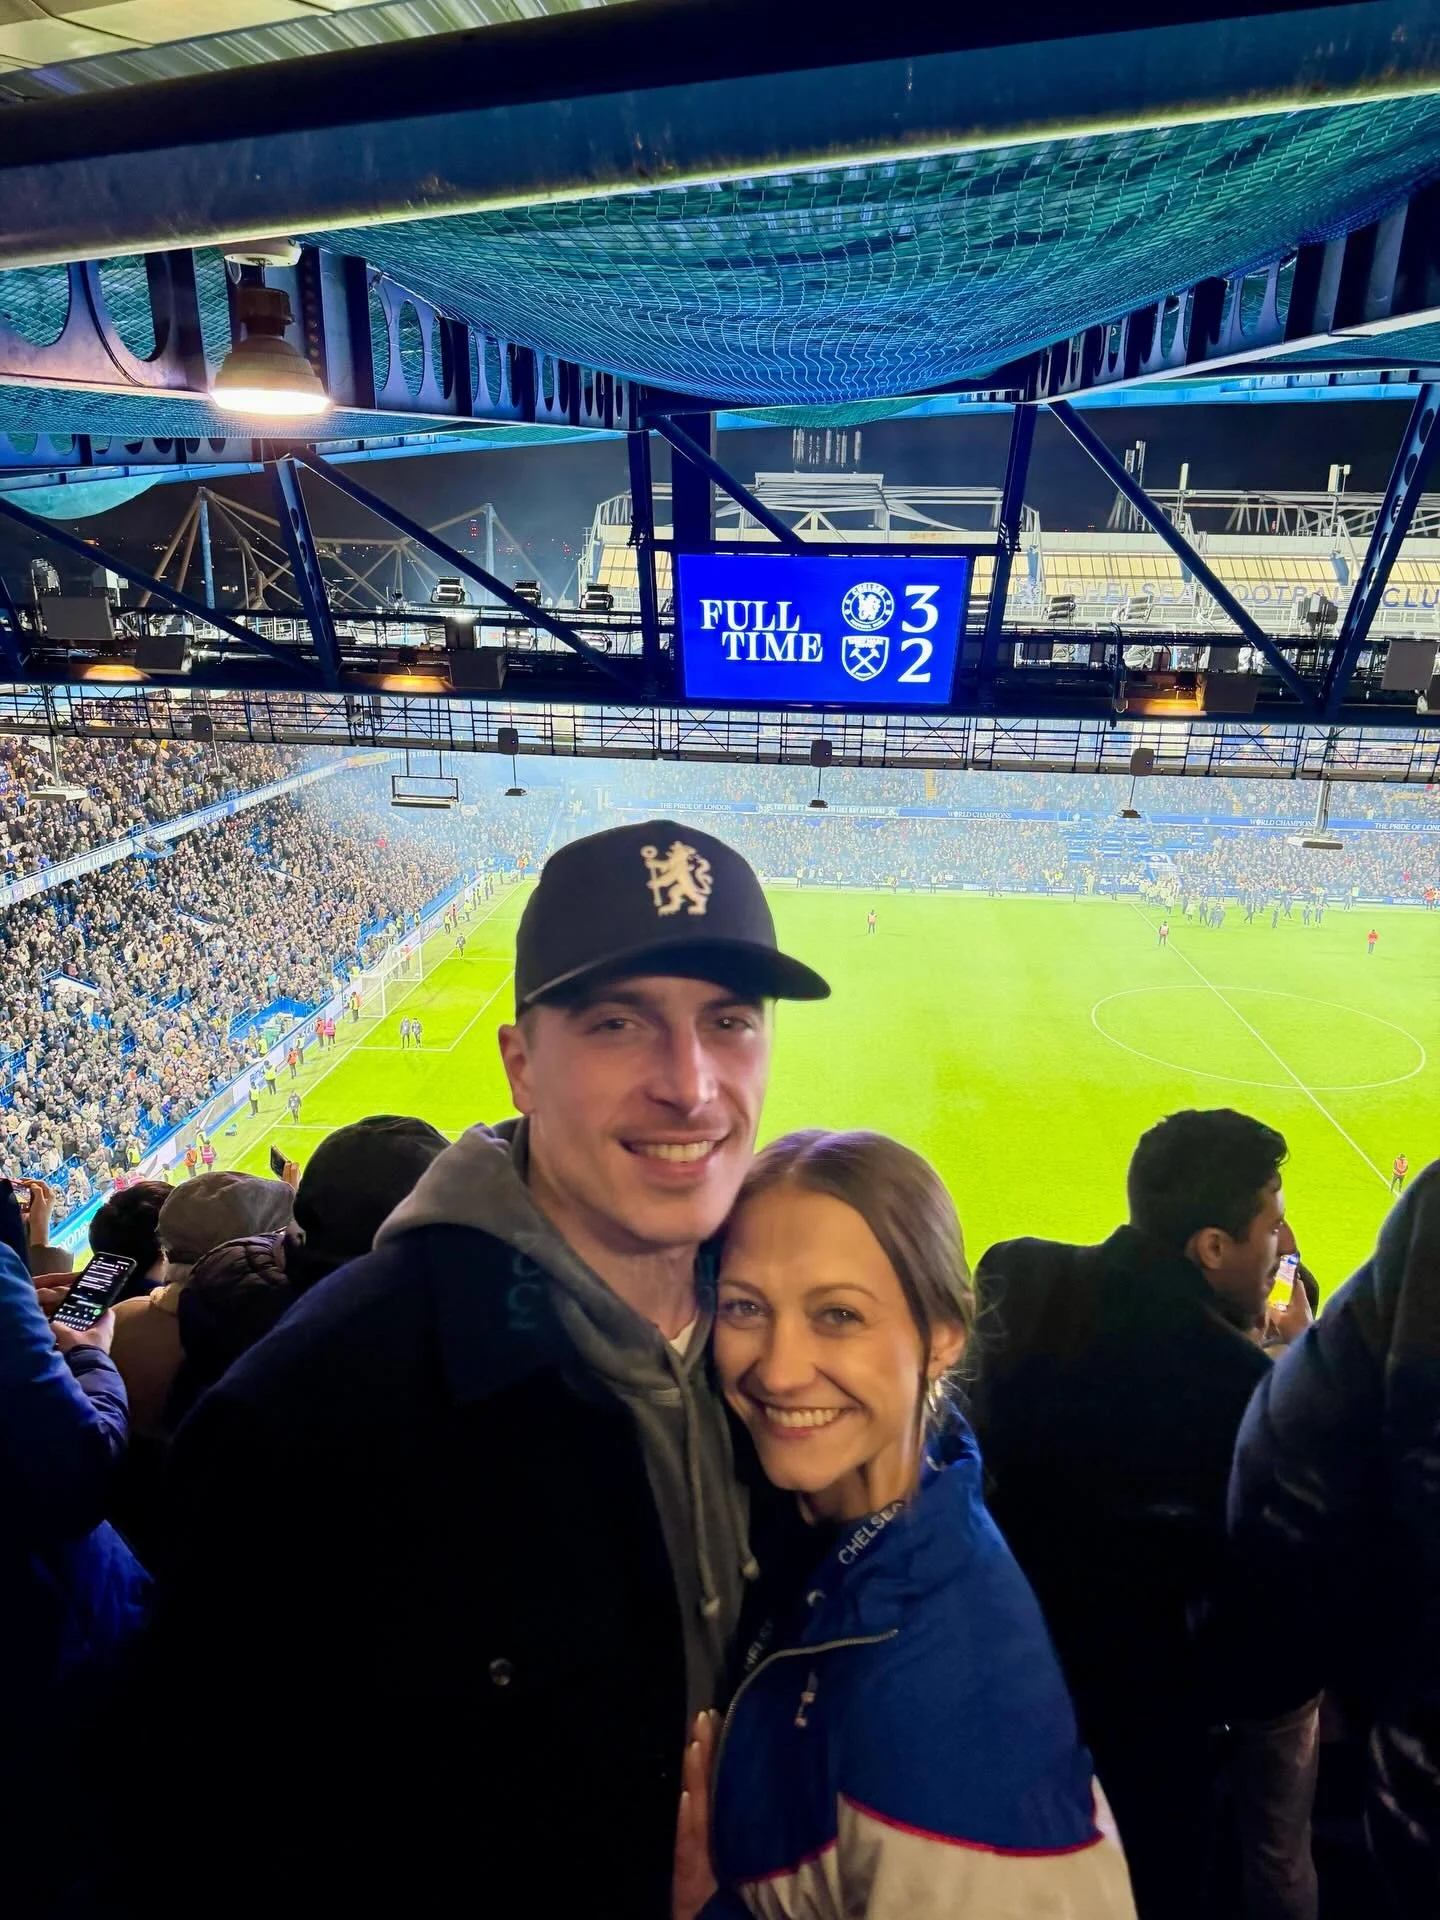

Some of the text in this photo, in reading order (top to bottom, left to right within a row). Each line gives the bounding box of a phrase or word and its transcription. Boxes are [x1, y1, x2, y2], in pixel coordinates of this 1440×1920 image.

[700, 600, 801, 632] FULL
[901, 585, 941, 633] 3
[721, 631, 824, 663] TIME
[897, 638, 934, 683] 2
[673, 802, 692, 810] PRIDE
[703, 803, 731, 811] LONDON
[972, 811, 1012, 819] CHAMPIONS
[1249, 818, 1317, 827] WORLD CHAMPIONS
[1374, 822, 1389, 830] THE
[837, 1501, 905, 1565] CHELSEA
